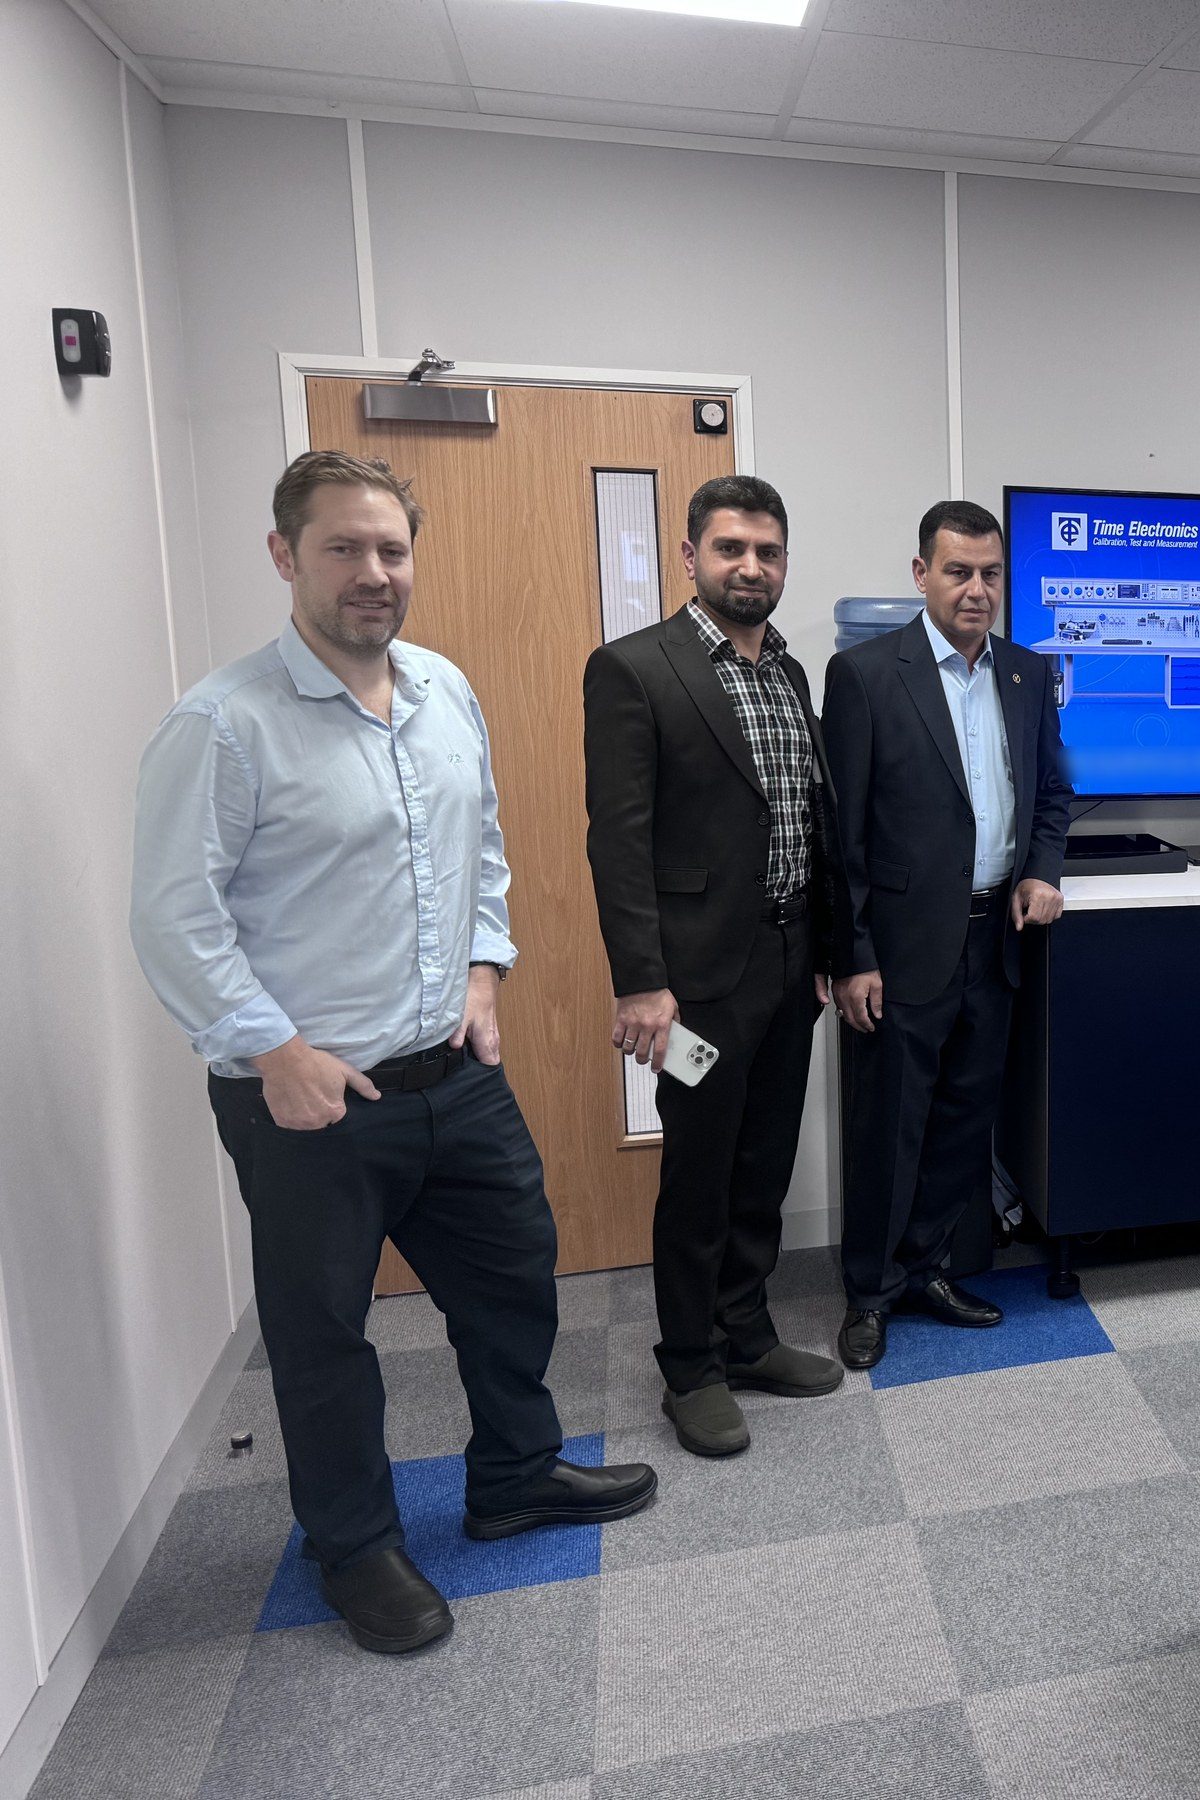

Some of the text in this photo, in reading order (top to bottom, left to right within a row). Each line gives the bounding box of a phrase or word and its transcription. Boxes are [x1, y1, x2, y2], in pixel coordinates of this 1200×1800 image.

[1092, 519, 1199, 538] Time Electronics
[1092, 537, 1198, 549] Calibration, Test and Measurement
